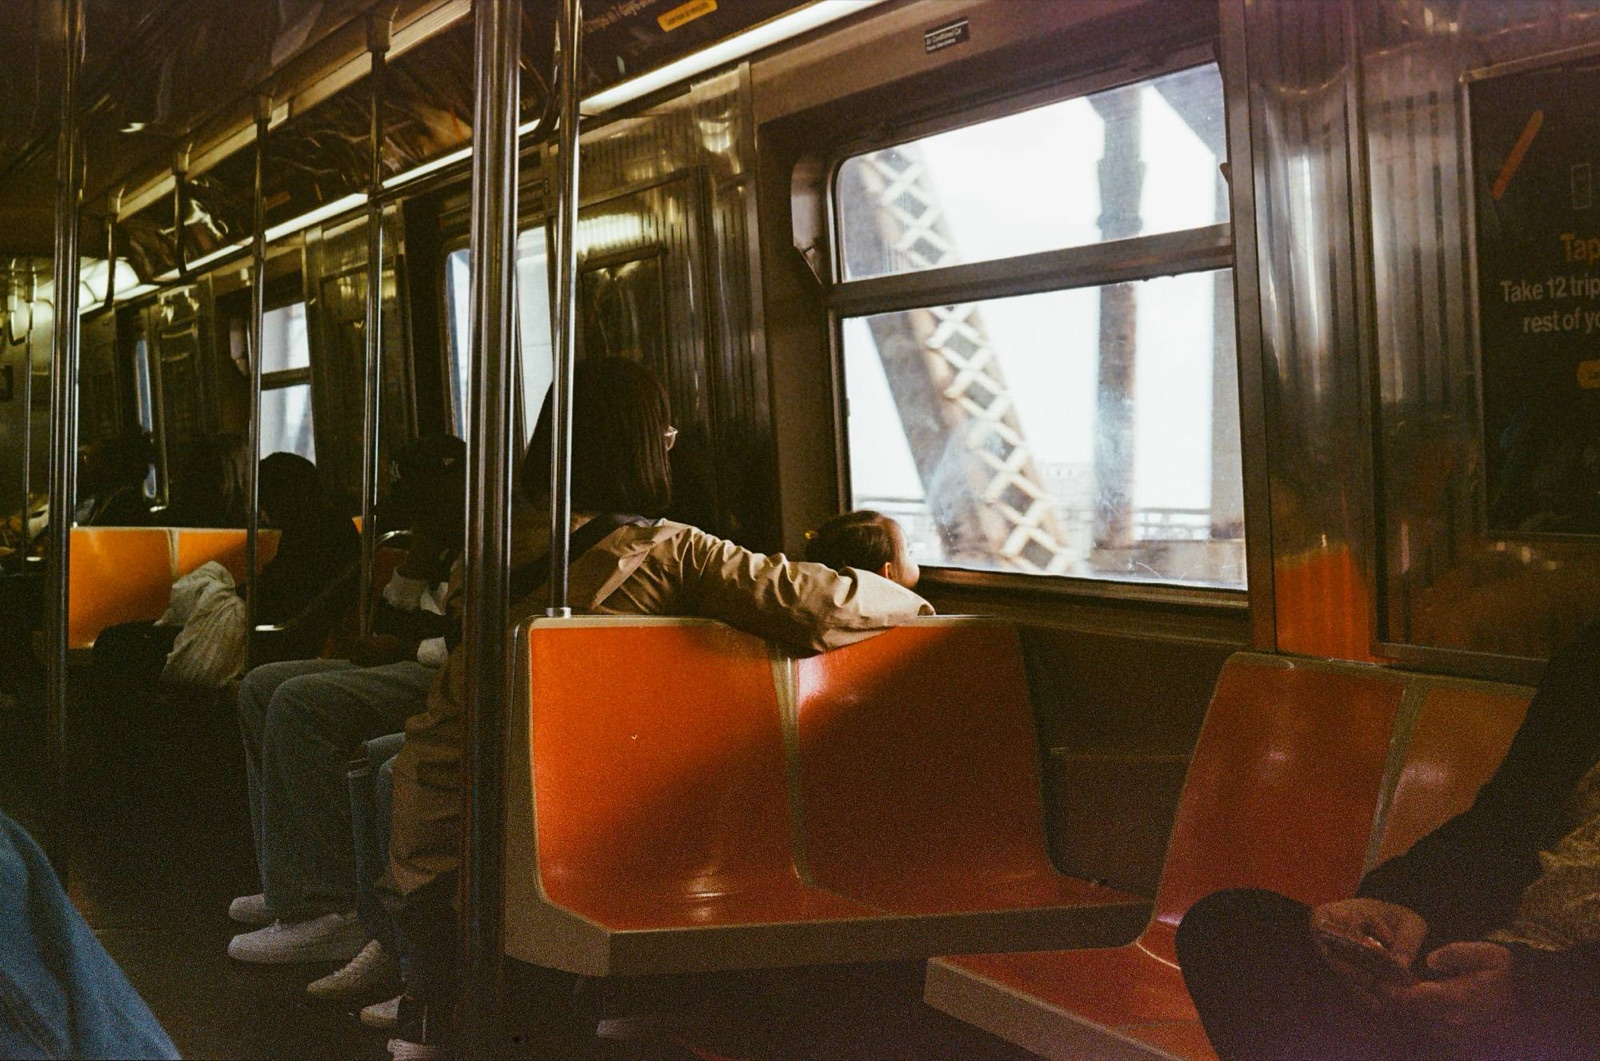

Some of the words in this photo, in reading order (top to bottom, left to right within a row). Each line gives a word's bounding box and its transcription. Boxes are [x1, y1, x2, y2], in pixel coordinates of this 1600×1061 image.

[1560, 232, 1600, 268] Tap
[1500, 279, 1544, 303] Take
[1546, 276, 1568, 299] 12
[1522, 310, 1560, 334] rest
[1562, 307, 1581, 331] of
